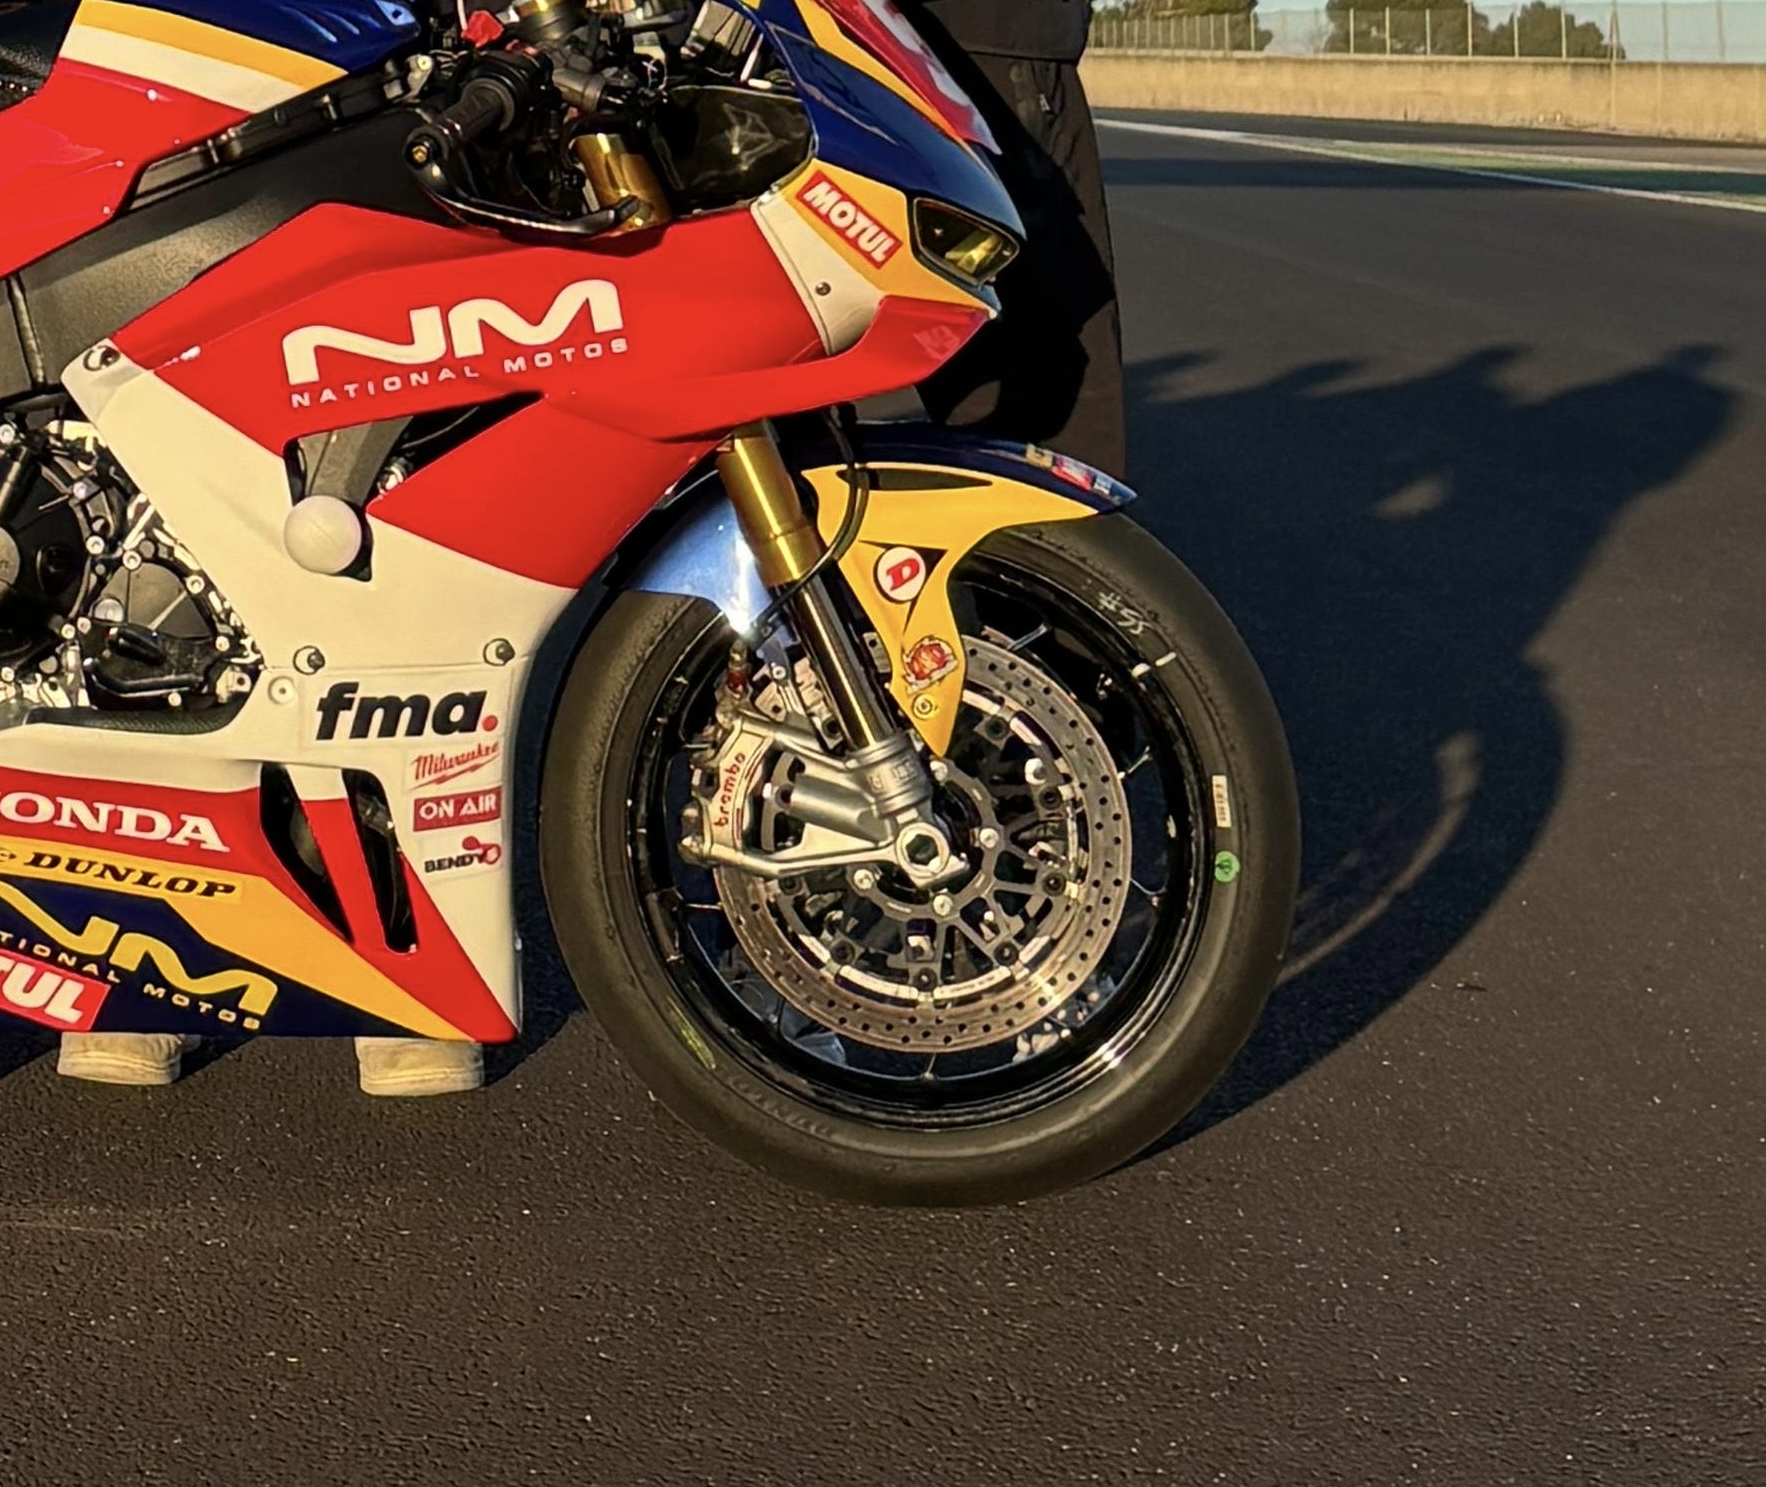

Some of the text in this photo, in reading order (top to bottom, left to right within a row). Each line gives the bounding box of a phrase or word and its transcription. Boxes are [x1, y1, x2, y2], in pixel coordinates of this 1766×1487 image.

[802, 180, 896, 263] MOTUL
[281, 279, 624, 386] NM
[290, 336, 629, 410] NATIONAL MOTOS
[315, 680, 499, 741] fma.
[419, 793, 497, 820] ON AIR
[714, 751, 746, 828] brembo
[24, 851, 237, 897] DUNLOP
[142, 982, 261, 1031] MOTOS
